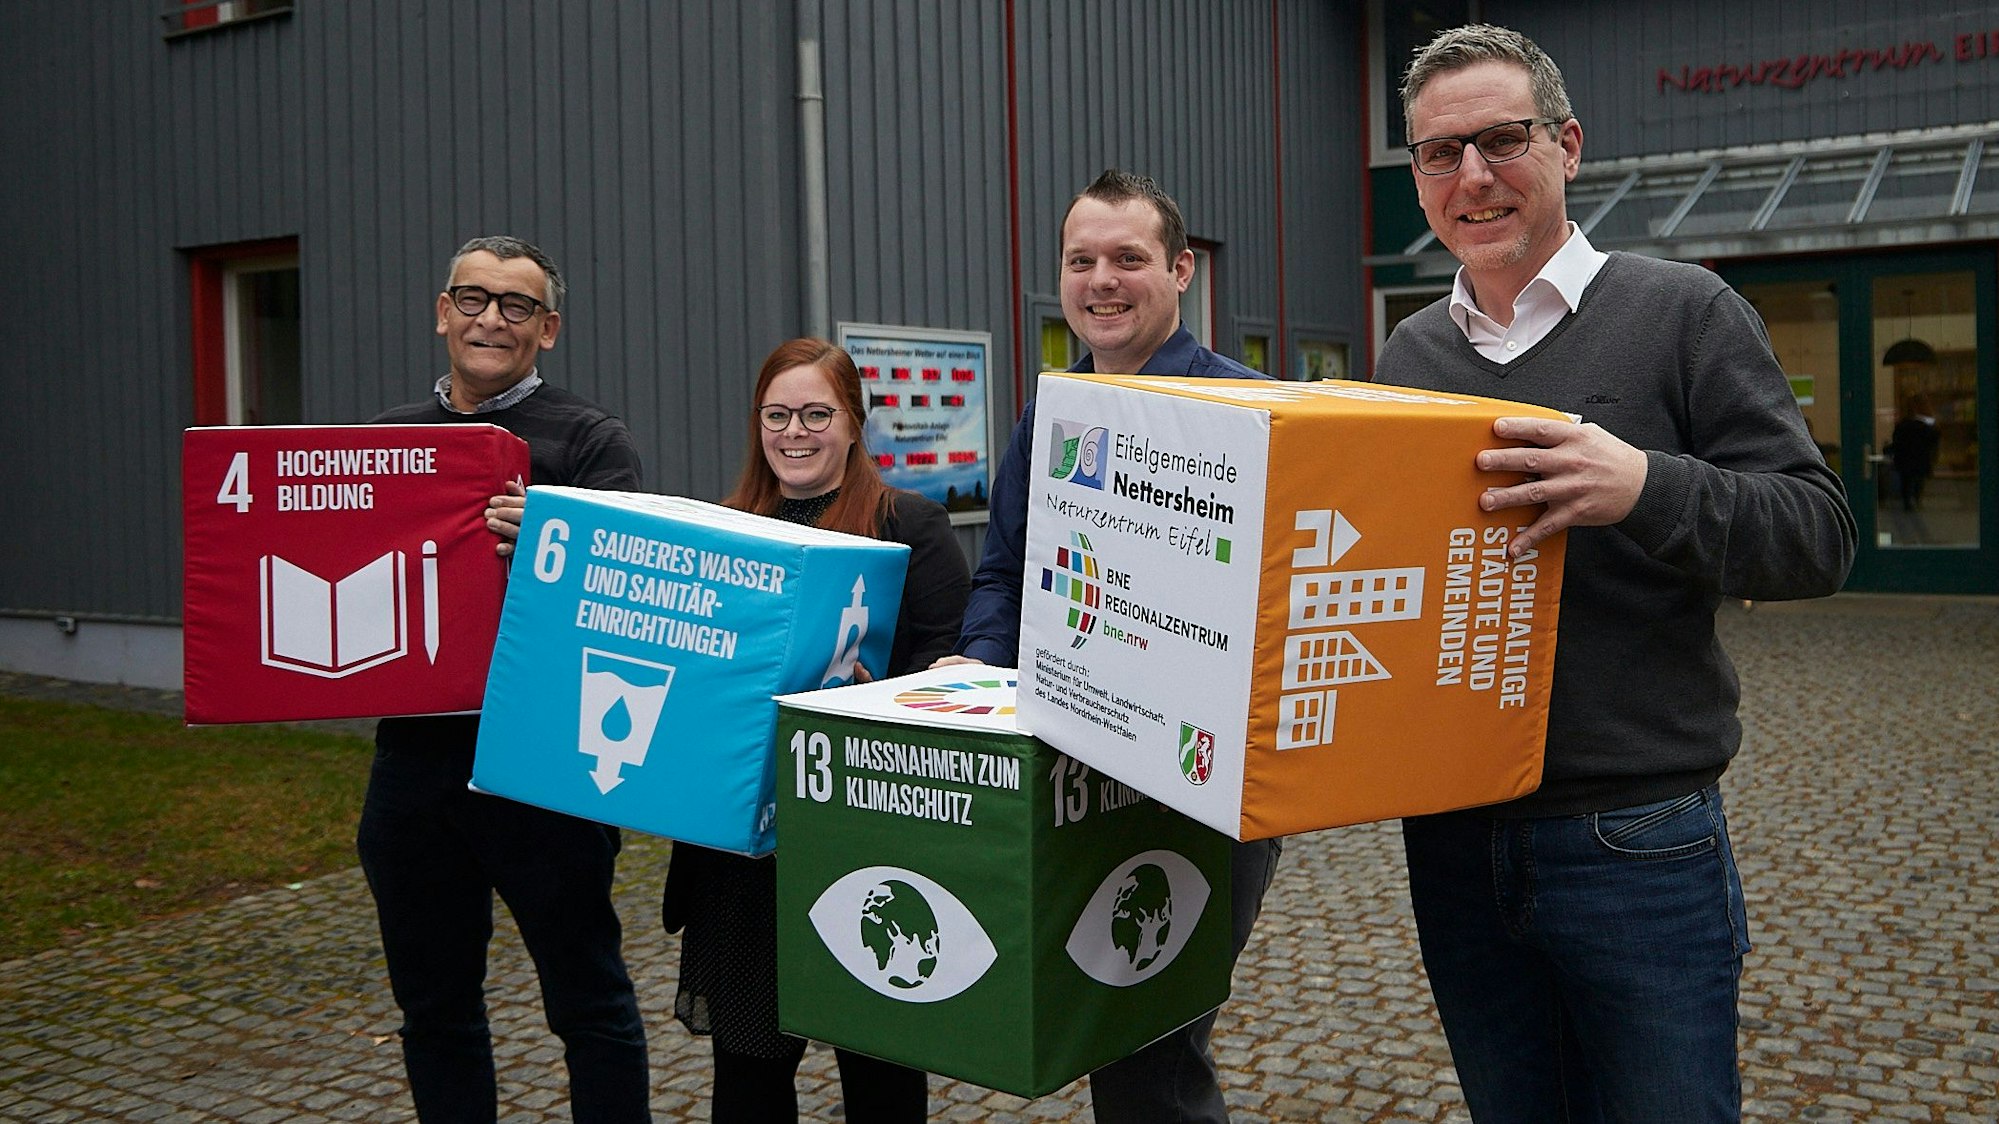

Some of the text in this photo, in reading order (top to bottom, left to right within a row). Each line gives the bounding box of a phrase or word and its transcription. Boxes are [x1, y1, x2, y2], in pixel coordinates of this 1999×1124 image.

[1657, 40, 1943, 94] Naturzentrum
[217, 452, 253, 513] 4
[277, 448, 437, 477] HOCHWERTIGE
[1116, 434, 1237, 483] Eifelgemeinde
[277, 483, 374, 511] BILDUNG
[1047, 493, 1212, 556] Naturzentrum Eifel
[1113, 471, 1234, 524] Nettersheim
[534, 518, 570, 584] 6
[590, 528, 786, 595] SAUBERES WASSER
[583, 564, 723, 618] UND SANITÄR-
[1106, 568, 1131, 590] BNE
[1436, 527, 1476, 686] GEMEINDEN
[576, 598, 738, 660] EINRICHTUNGEN
[1103, 620, 1149, 651] bne.nrw
[1105, 594, 1229, 651] REGIONALZENTRUM
[1469, 526, 1509, 691] STÄDTE UND
[1499, 526, 1539, 709] ACHHALTIGE
[1036, 648, 1090, 678] gefördert durch:
[1035, 687, 1137, 742] des Landes Nordrhein-Westfalen
[1036, 660, 1166, 726] Ministerium für Umwelt, Landwirtschaft,
[1036, 673, 1130, 724] Natur- und Verbraucherschutz
[790, 730, 833, 802] 13
[844, 736, 1020, 791] MASSNAHMEN ZUM
[1049, 754, 1090, 828] 13
[845, 777, 973, 826] KLIMASCHUTZ
